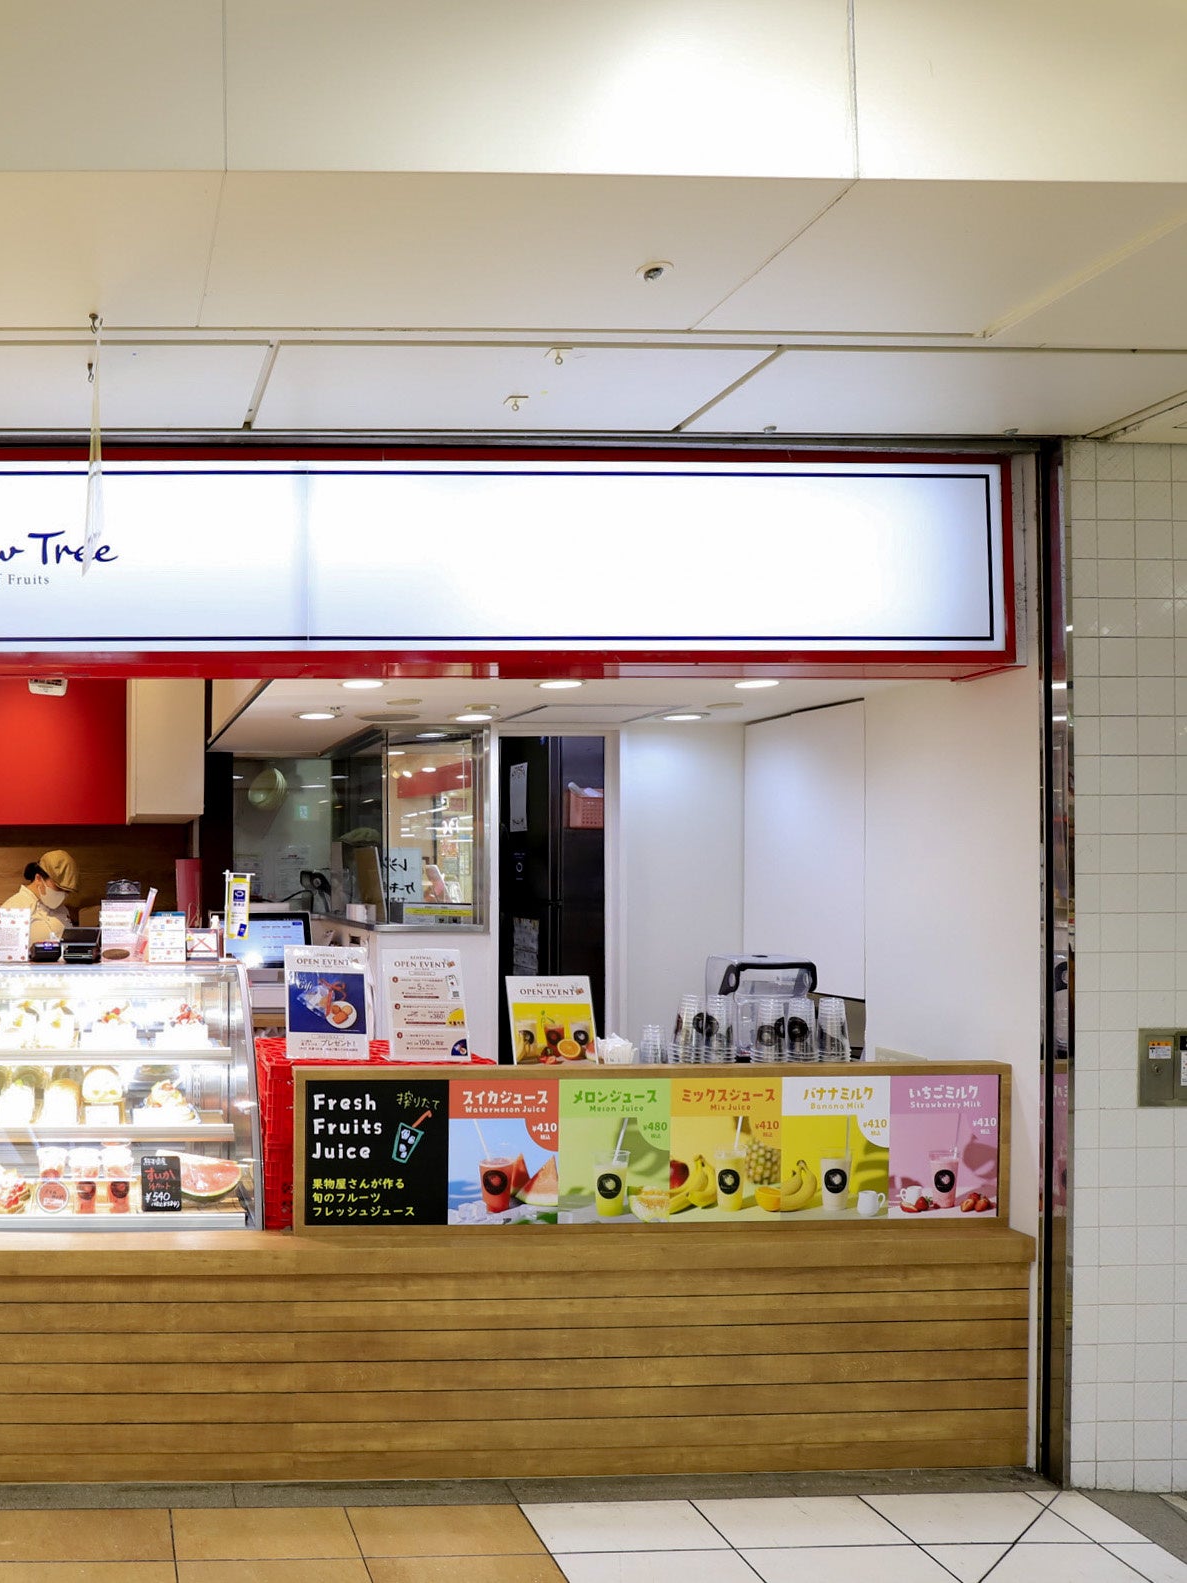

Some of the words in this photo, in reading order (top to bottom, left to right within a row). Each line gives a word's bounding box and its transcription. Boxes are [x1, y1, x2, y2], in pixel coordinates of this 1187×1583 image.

[27, 529, 118, 565] Tree
[7, 573, 50, 586] Fruits
[322, 958, 350, 966] EVENT
[546, 988, 575, 996] EVENT
[320, 1039, 356, 1048] プレゼント!
[462, 1090, 549, 1105] スイカジュース
[573, 1089, 658, 1104] メロンジュース
[681, 1088, 776, 1103] ミックスジュース
[803, 1086, 874, 1101] バナナミルク
[908, 1084, 979, 1100] いちごミルク
[313, 1094, 377, 1111] Fresh
[396, 1090, 440, 1110] 搾りたて
[910, 1101, 961, 1109] Strawberry
[465, 1105, 520, 1113] Watermelon
[522, 1105, 546, 1113] Juice
[620, 1104, 644, 1112] Juice
[728, 1103, 751, 1111] Juice
[810, 1102, 845, 1110] Banana
[846, 1102, 865, 1110] Milk
[313, 1118, 383, 1135] Fruits
[531, 1122, 557, 1133] ¥410
[643, 1121, 668, 1132] ¥480
[755, 1120, 780, 1130] ¥410
[863, 1119, 888, 1129] ¥410
[972, 1117, 997, 1127] ¥410
[312, 1142, 371, 1159] Juice
[144, 1167, 176, 1182] すいか
[312, 1178, 405, 1190] 果物屋さんが作る
[145, 1191, 171, 1203] ¥540
[312, 1192, 381, 1203] 旬のフルーツ
[312, 1206, 415, 1217] フレッシュジュース
